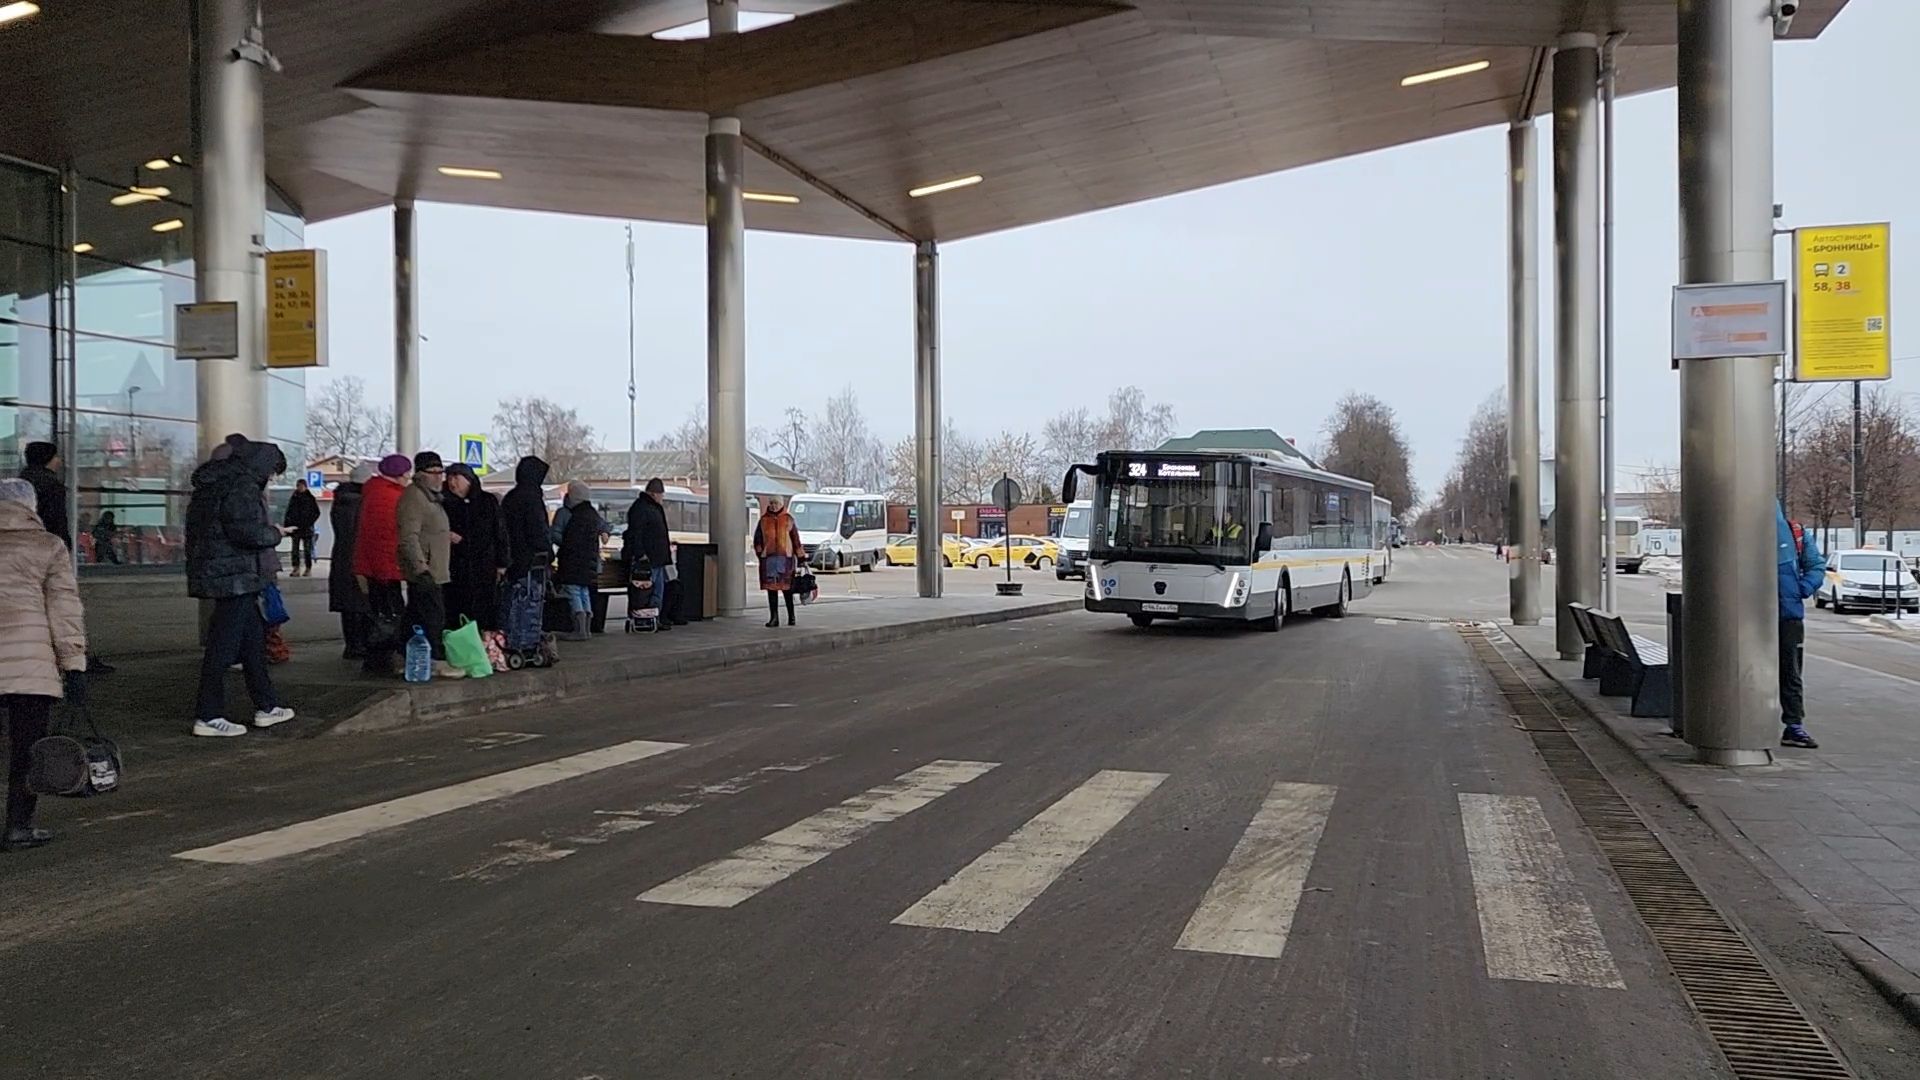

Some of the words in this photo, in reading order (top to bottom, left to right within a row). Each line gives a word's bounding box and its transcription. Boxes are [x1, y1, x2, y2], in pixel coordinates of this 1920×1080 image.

[1837, 264, 1846, 275] 2
[1813, 282, 1832, 292] 58,
[1836, 281, 1851, 291] 38
[1128, 463, 1147, 476] 324
[310, 472, 319, 485] P
